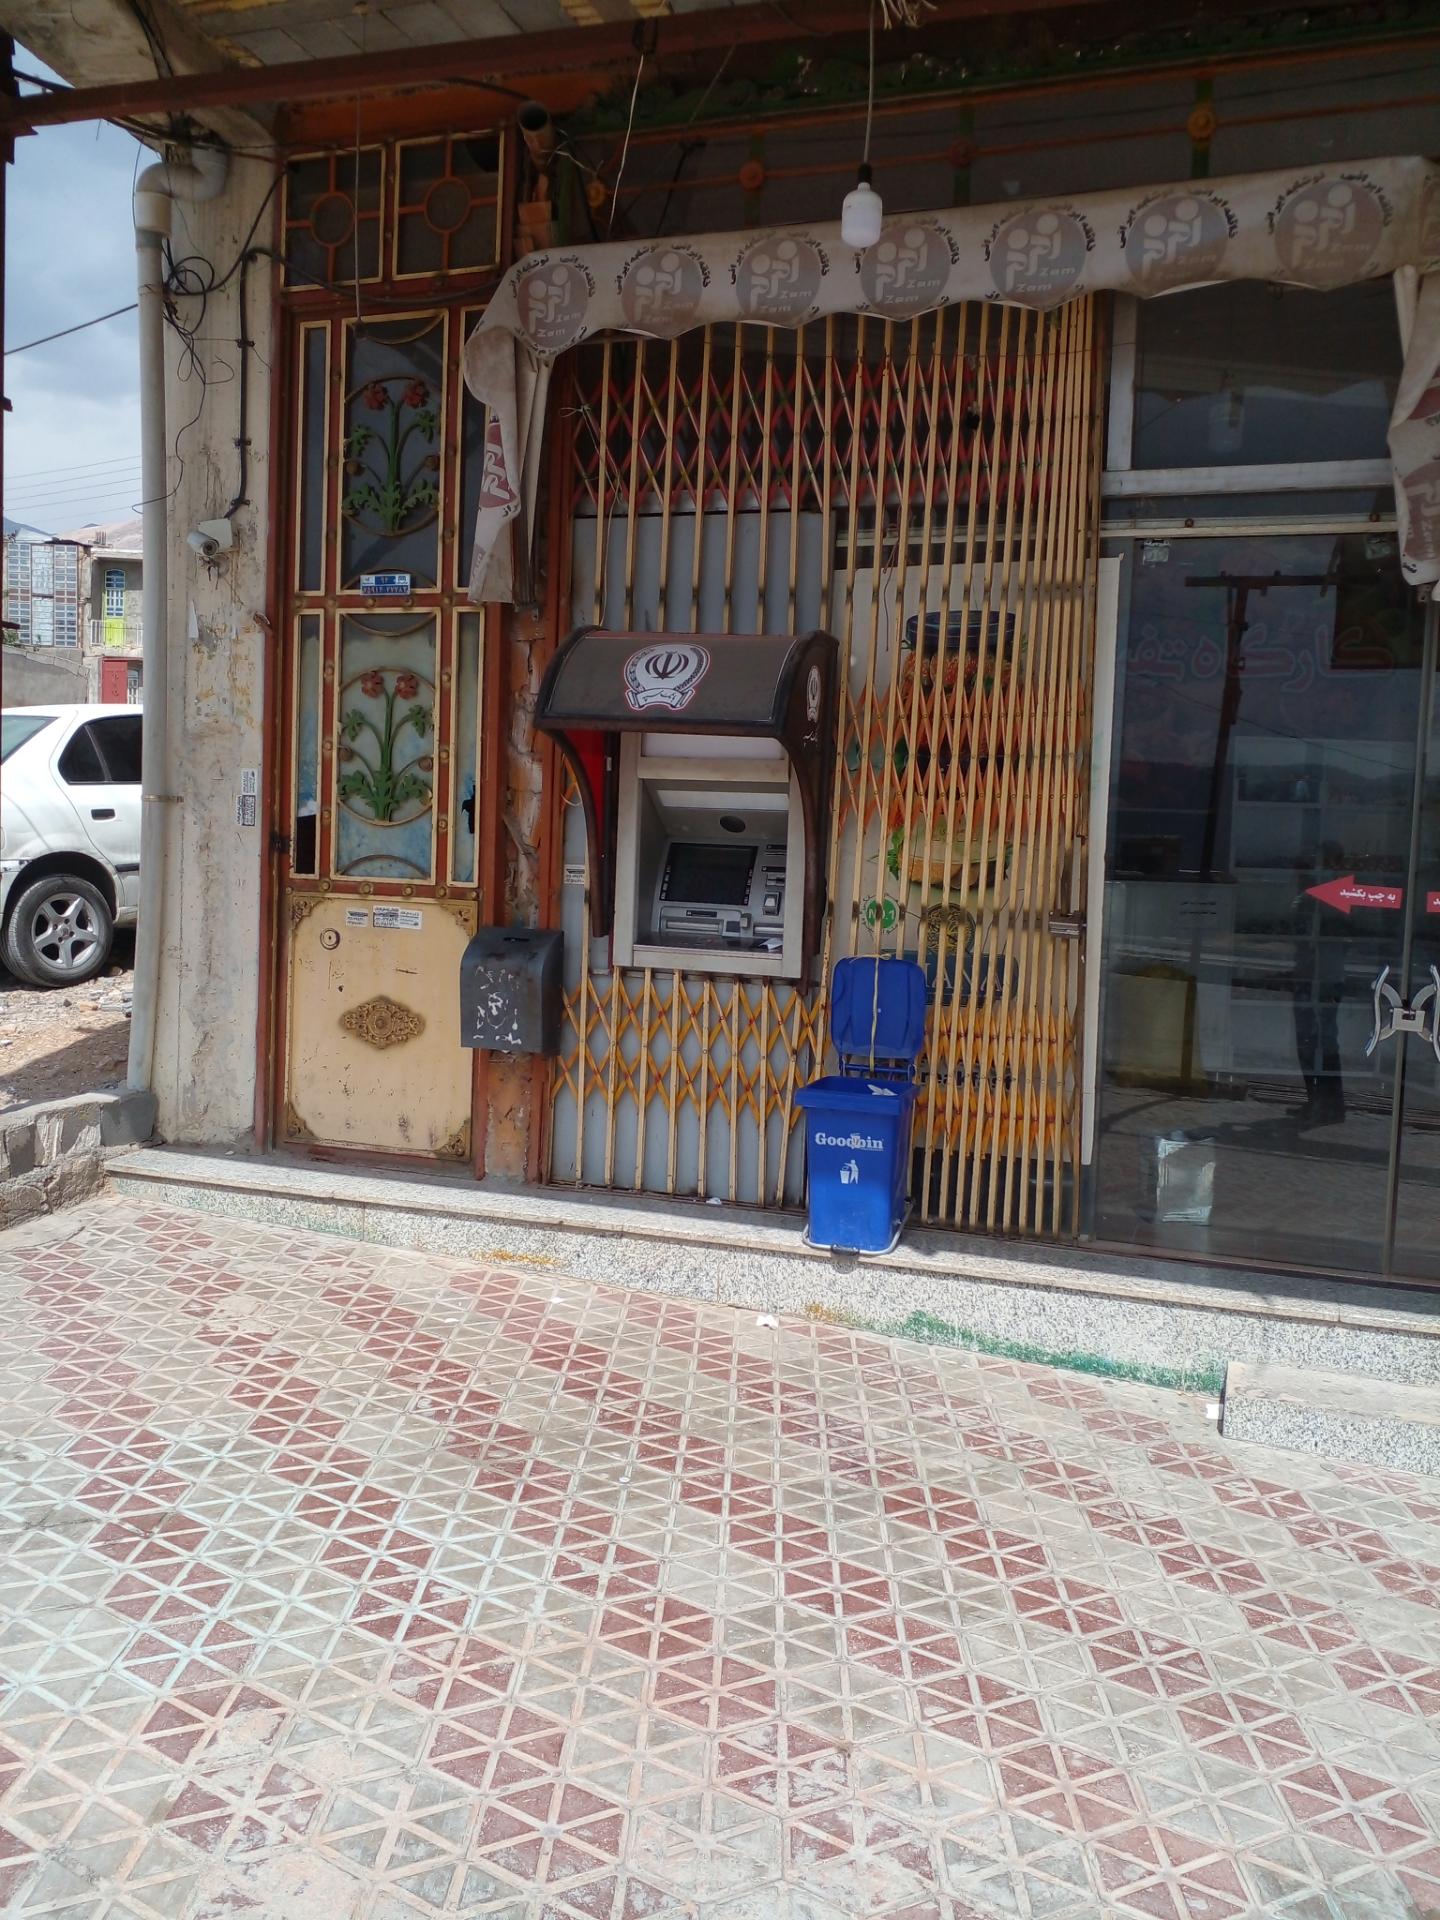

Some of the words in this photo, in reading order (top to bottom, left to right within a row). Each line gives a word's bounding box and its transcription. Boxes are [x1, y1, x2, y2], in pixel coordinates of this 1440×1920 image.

[1339, 887, 1367, 900] بکشید
[1367, 892, 1385, 903] چپ
[1386, 893, 1396, 903] به
